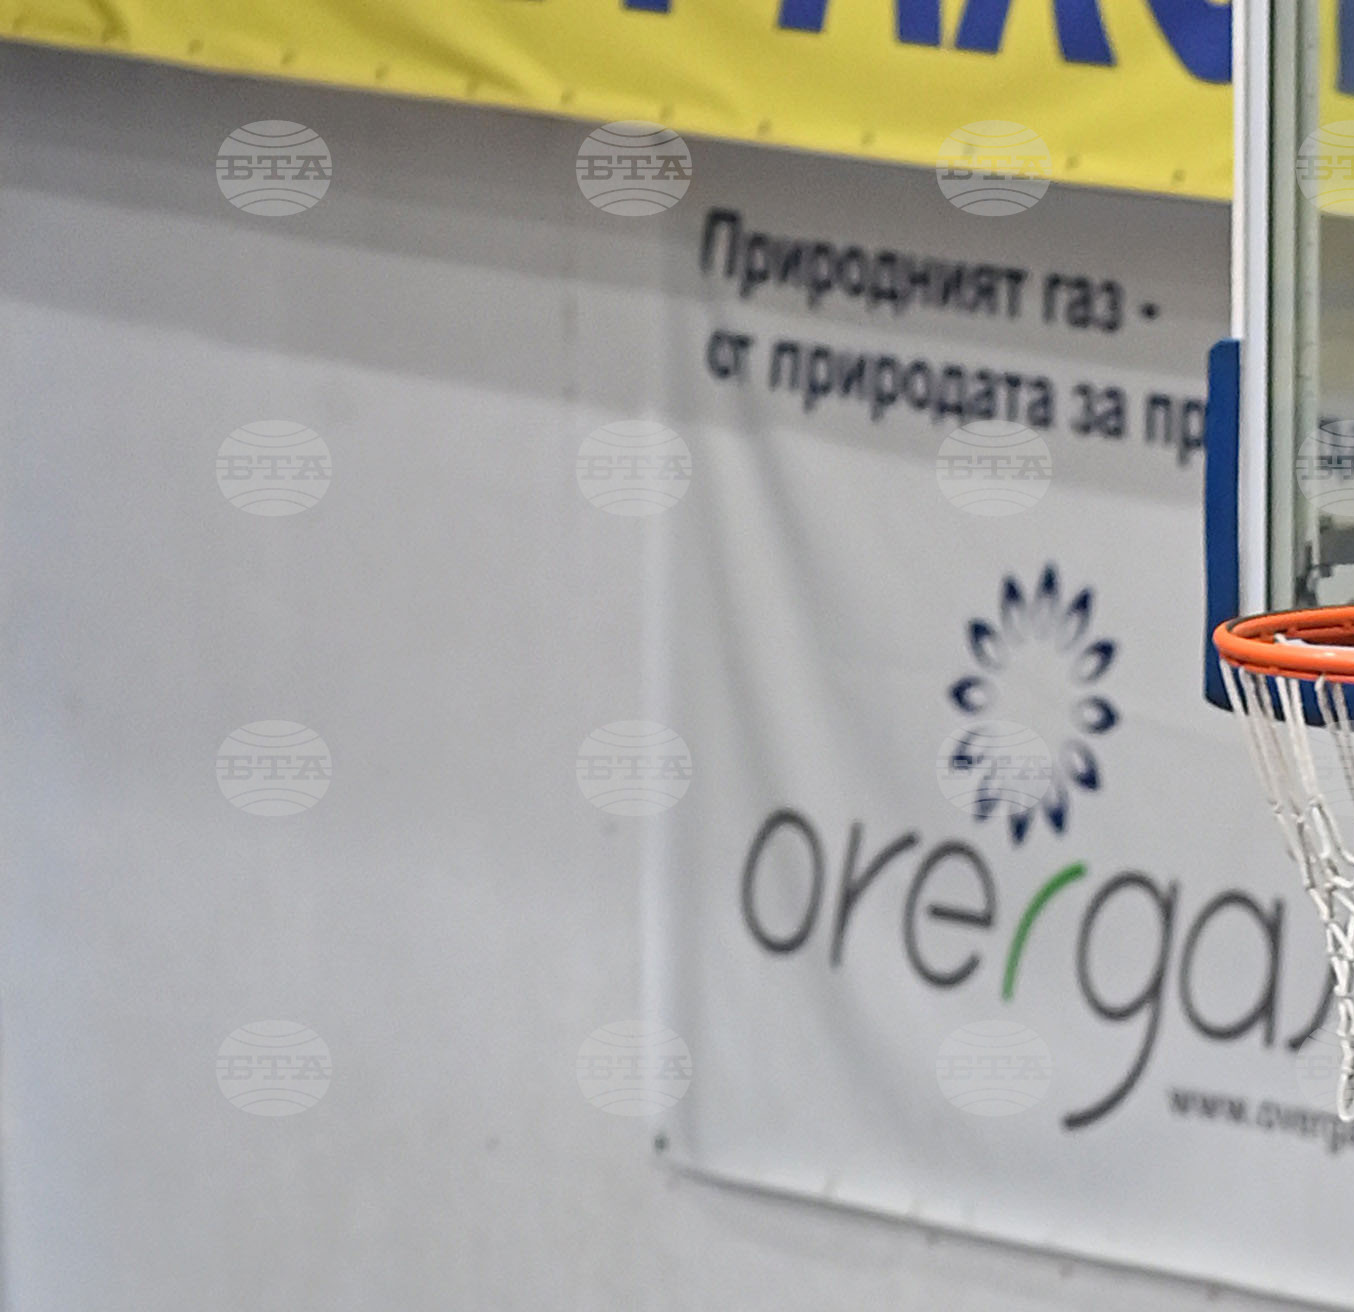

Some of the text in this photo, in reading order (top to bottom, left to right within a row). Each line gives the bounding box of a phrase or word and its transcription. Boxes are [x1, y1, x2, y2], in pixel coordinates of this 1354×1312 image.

[702, 207, 1028, 318] Природният
[1043, 272, 1127, 334] газ
[706, 329, 1207, 470] от природата за пр
